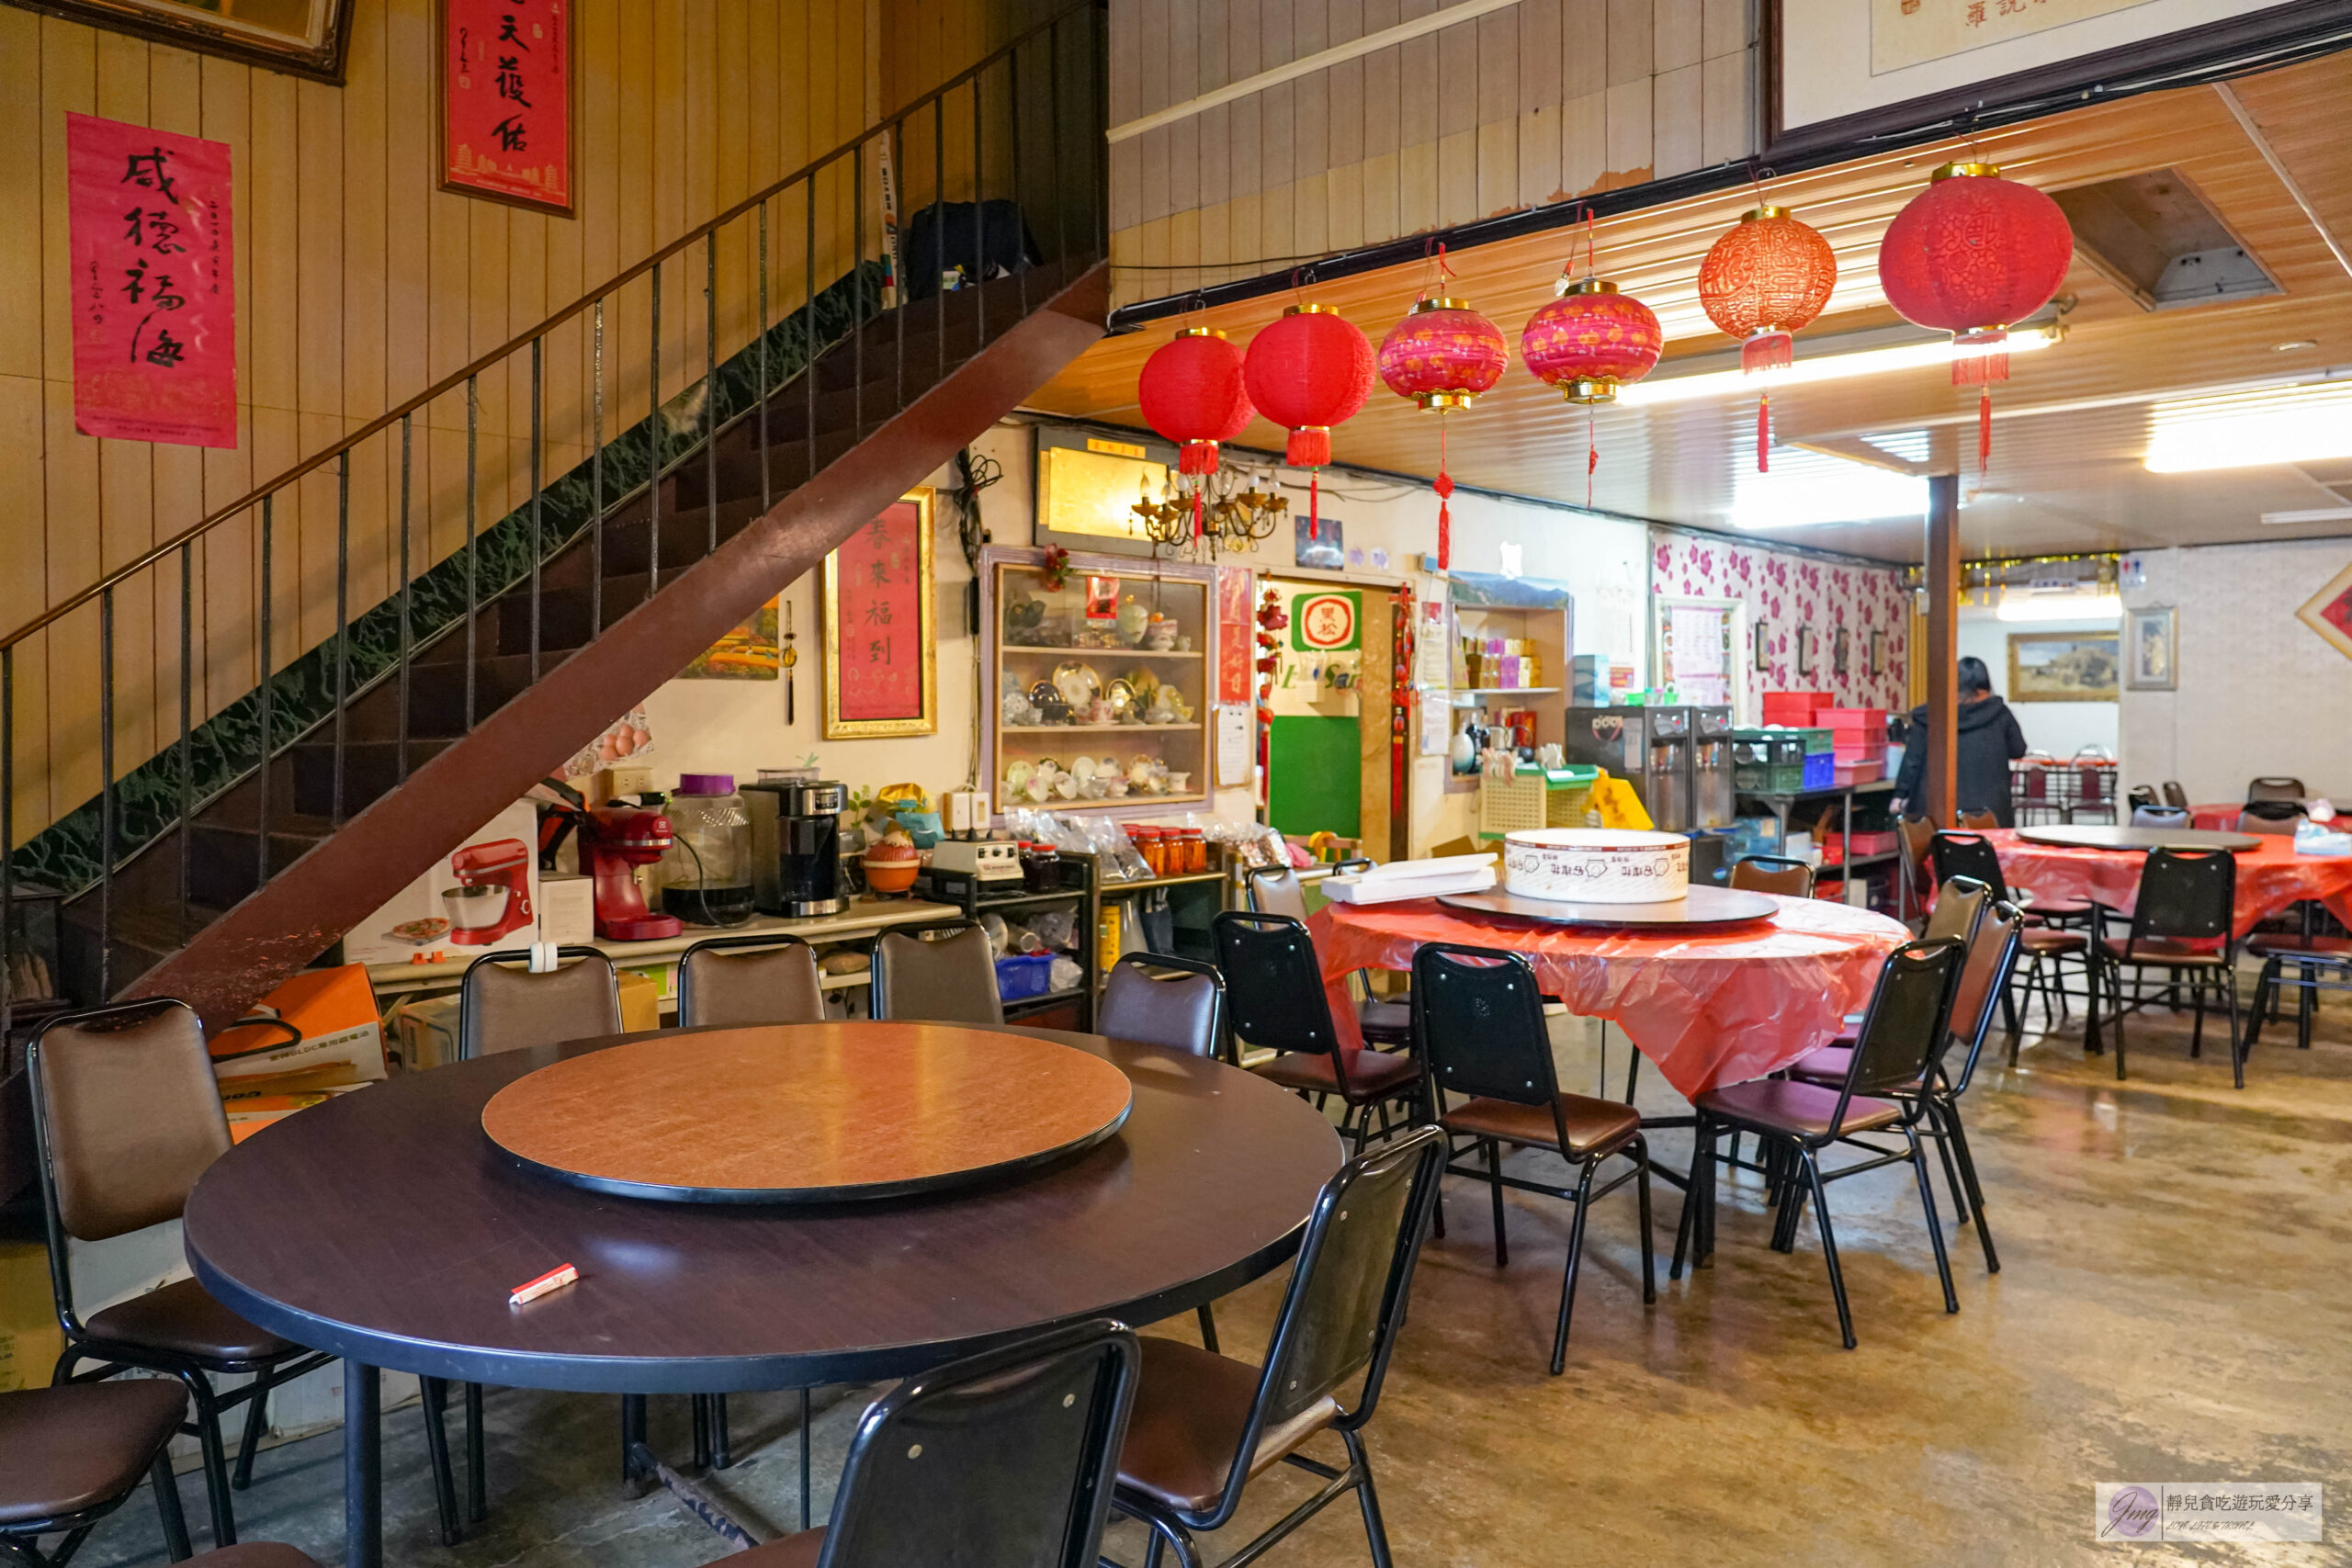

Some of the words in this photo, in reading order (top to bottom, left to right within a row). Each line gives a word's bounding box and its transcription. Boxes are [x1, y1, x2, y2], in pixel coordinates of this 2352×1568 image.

[865, 513, 894, 666] 春來福到
[1317, 606, 1338, 636] 黑松
